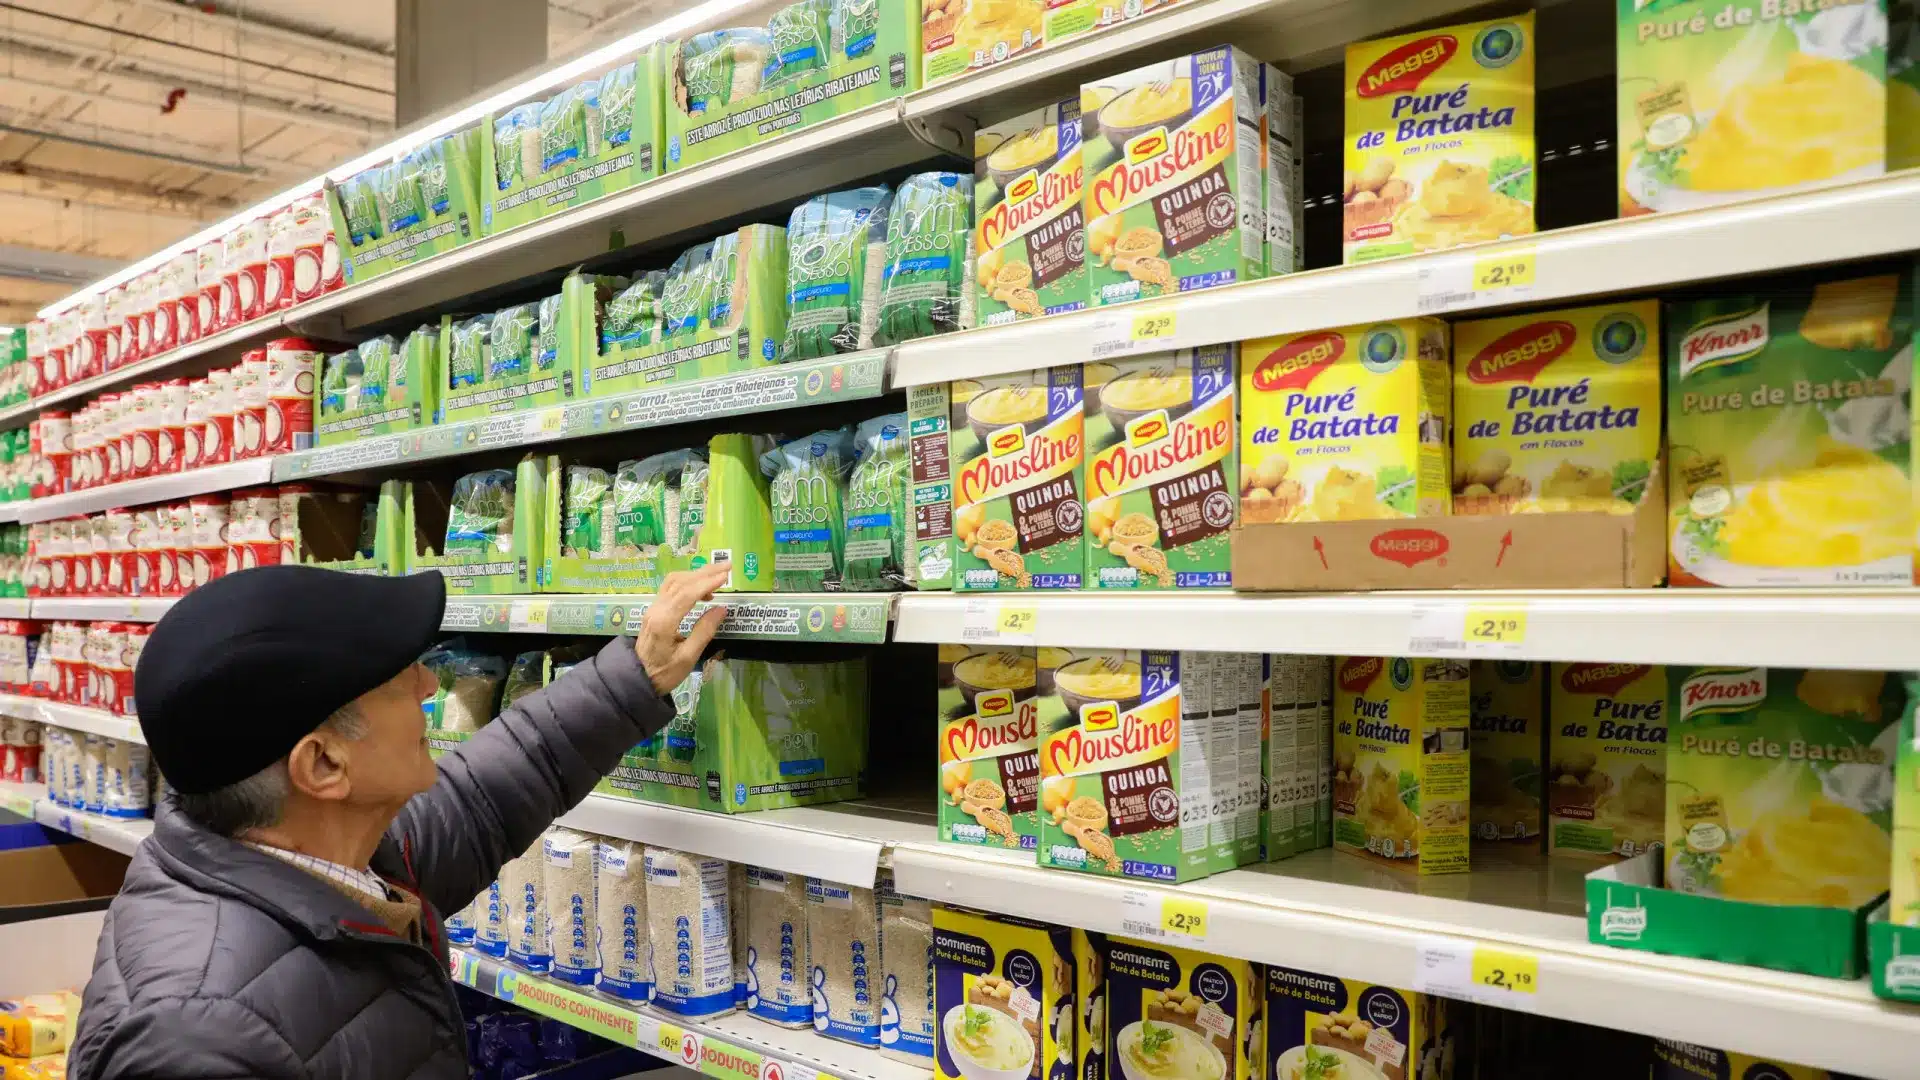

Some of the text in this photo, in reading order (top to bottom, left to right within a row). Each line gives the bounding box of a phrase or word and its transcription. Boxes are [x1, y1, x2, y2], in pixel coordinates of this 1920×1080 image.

[1639, 5, 1752, 42] Puré de
[1367, 41, 1445, 90] Maggi
[687, 130, 704, 145] ESTE
[704, 120, 727, 139] ARROZ
[733, 103, 773, 129] PRODUZIDO
[775, 99, 790, 116] NAS
[791, 87, 824, 111] LEZÍRIAS
[825, 67, 880, 99] RIBATEJANAS
[1198, 81, 1212, 107] 2
[1392, 82, 1470, 118] Puré
[1357, 107, 1515, 149] de Batata
[1404, 139, 1462, 155] em Flocos
[1094, 123, 1228, 215] Mousline
[1161, 172, 1224, 216] QUINOA
[983, 165, 1083, 250] Mousline
[1031, 211, 1080, 250] QUINOA
[1164, 219, 1177, 239] &
[1175, 207, 1204, 227] POMME
[1033, 242, 1063, 271] & POMME
[1480, 329, 1562, 376] Maggi
[1686, 324, 1764, 362] Knorr
[1262, 339, 1334, 384] Maggi
[735, 377, 786, 393] Ribatejanas
[912, 389, 935, 399] FACILE
[1508, 377, 1590, 410] Puré
[1682, 377, 1894, 414] Puré de Batata
[625, 413, 649, 423] normas
[650, 412, 657, 421] de
[688, 404, 711, 415] amigas
[722, 398, 755, 410] ambiente
[1285, 387, 1356, 416] Puré
[1253, 414, 1399, 444] de Batata
[1468, 406, 1639, 438] de Batata
[1296, 445, 1351, 455] em Flocos
[1520, 439, 1584, 450] em Flocos
[962, 433, 1079, 504] Mousline
[1095, 419, 1227, 496] Mousline
[772, 476, 827, 507] BOM
[1017, 480, 1073, 512] QUINOA
[1158, 470, 1222, 505] QUINOA
[773, 506, 827, 524] SUCESSO
[1019, 517, 1030, 535] &
[1029, 509, 1053, 524] POMME
[1038, 518, 1054, 530] TERRE
[1162, 509, 1173, 530] &
[1172, 501, 1200, 517] POMME
[1182, 510, 1201, 524] TERRE
[1379, 537, 1438, 552] Maggi
[737, 606, 788, 619] Ribatejanas
[724, 623, 756, 632] ambiente
[764, 623, 773, 632] da
[1343, 656, 1378, 684] Maggi
[1147, 674, 1160, 696] 2
[1686, 679, 1762, 707] Knorr
[1354, 697, 1389, 720] Puré
[1594, 699, 1664, 720] Puré
[949, 703, 1037, 761] Mousli
[1339, 719, 1409, 744] de Batata
[1562, 721, 1667, 744] de Bata
[1051, 714, 1176, 776] Mousline
[1604, 745, 1657, 755] em Flocos
[1681, 734, 1885, 765] Puré de Batata
[1005, 754, 1039, 777] QUIN
[620, 768, 632, 780] NAS
[657, 772, 700, 789] RIBATEJANAS
[750, 786, 761, 795] ESTE
[761, 785, 774, 794] ARROZ
[1007, 778, 1018, 797] &
[1108, 766, 1168, 795] QUINOA
[1110, 797, 1121, 818] &
[1120, 794, 1145, 807] POMME
[1129, 804, 1147, 814] TERRE
[652, 868, 677, 877] COMUM
[824, 888, 849, 899] COMUM
[1168, 912, 1201, 933] €2,39
[936, 936, 986, 956] CONTINENTE
[936, 948, 986, 968] Puré de Batata
[1110, 962, 1170, 983] Puré de Batata
[1111, 950, 1170, 971] CONTINENTE
[619, 970, 633, 980] 1kg
[1270, 970, 1335, 993] CONTINENTE
[1484, 968, 1531, 990] €2,19
[674, 985, 688, 994] 1kg
[1270, 982, 1335, 1006] Puré de Batata
[518, 982, 633, 1034] PRODUTOS CONTINENTE
[850, 1012, 867, 1023] 1kg
[832, 1022, 864, 1033] CONTINENTE
